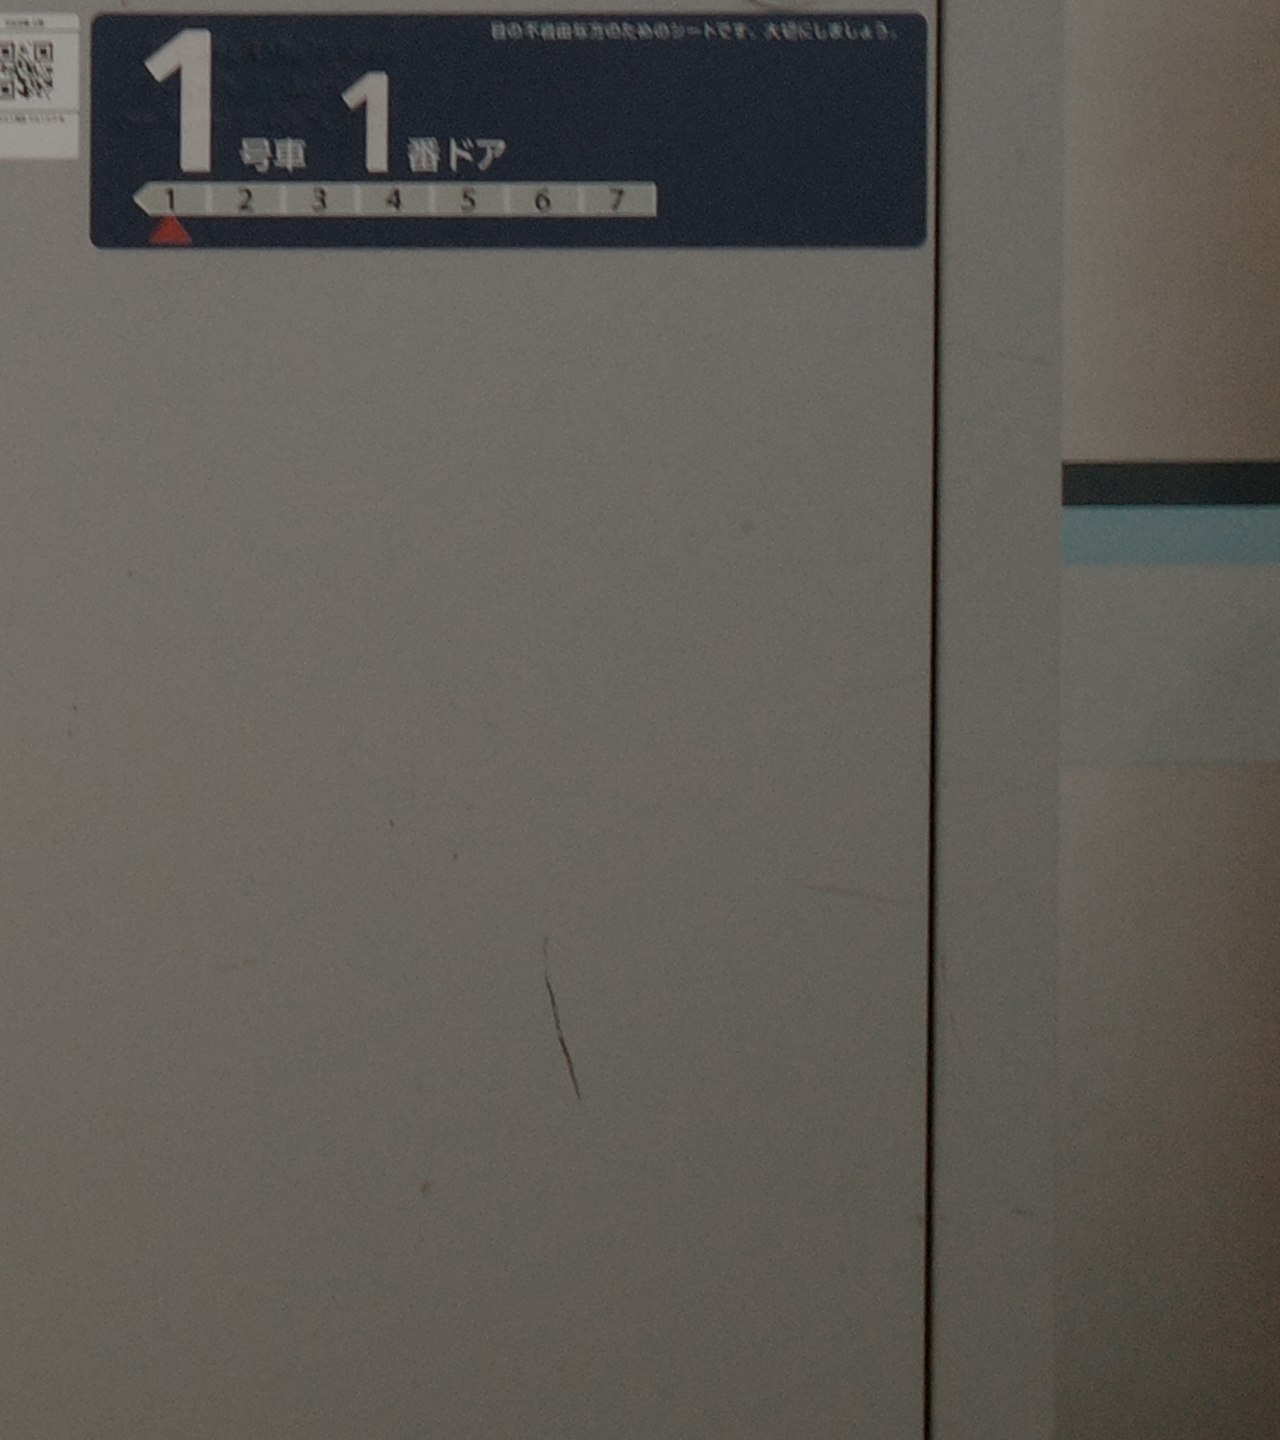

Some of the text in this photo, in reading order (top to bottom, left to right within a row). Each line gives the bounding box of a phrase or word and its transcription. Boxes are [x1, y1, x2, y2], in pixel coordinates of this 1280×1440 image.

[143, 27, 507, 173] 1 号車 1 番ドア
[164, 189, 625, 212] 1 2 3 4 5 6 7
